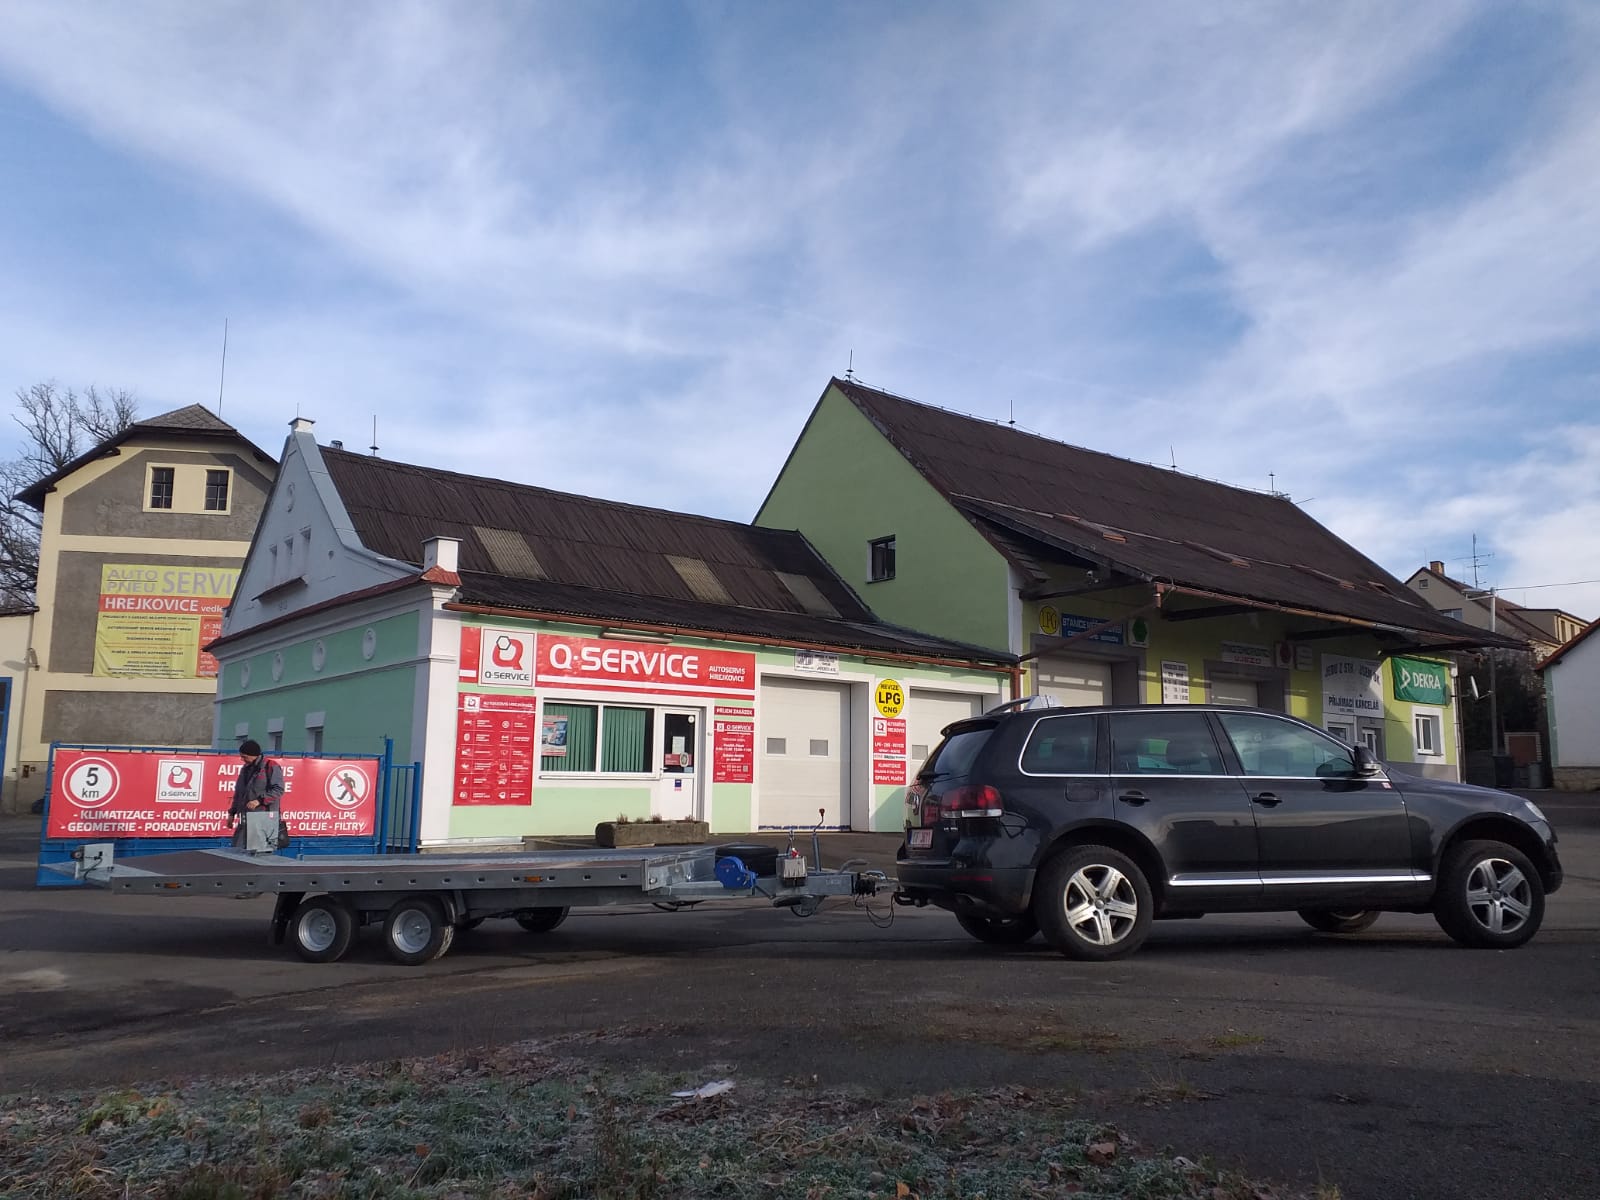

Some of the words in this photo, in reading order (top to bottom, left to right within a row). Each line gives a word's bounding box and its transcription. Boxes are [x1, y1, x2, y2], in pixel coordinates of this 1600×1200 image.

[108, 569, 158, 580] AUTO
[107, 582, 155, 593] PNEU
[162, 571, 240, 595] SERVI
[105, 597, 199, 612] HREJKOVICE
[709, 665, 746, 675] AUTOSERVIS
[1412, 672, 1441, 689] DEKRA
[878, 692, 901, 705] LPG
[86, 767, 99, 786] 5
[82, 788, 99, 798] km
[80, 810, 155, 820] KLIMATIZACE
[163, 808, 197, 820] ROČNÍ
[338, 811, 356, 820] LPG
[67, 822, 136, 832] GEOMETRIE
[144, 820, 221, 832] PORADENSTVÍ
[298, 822, 327, 831] OLEJE
[334, 822, 365, 831] FILTRY
